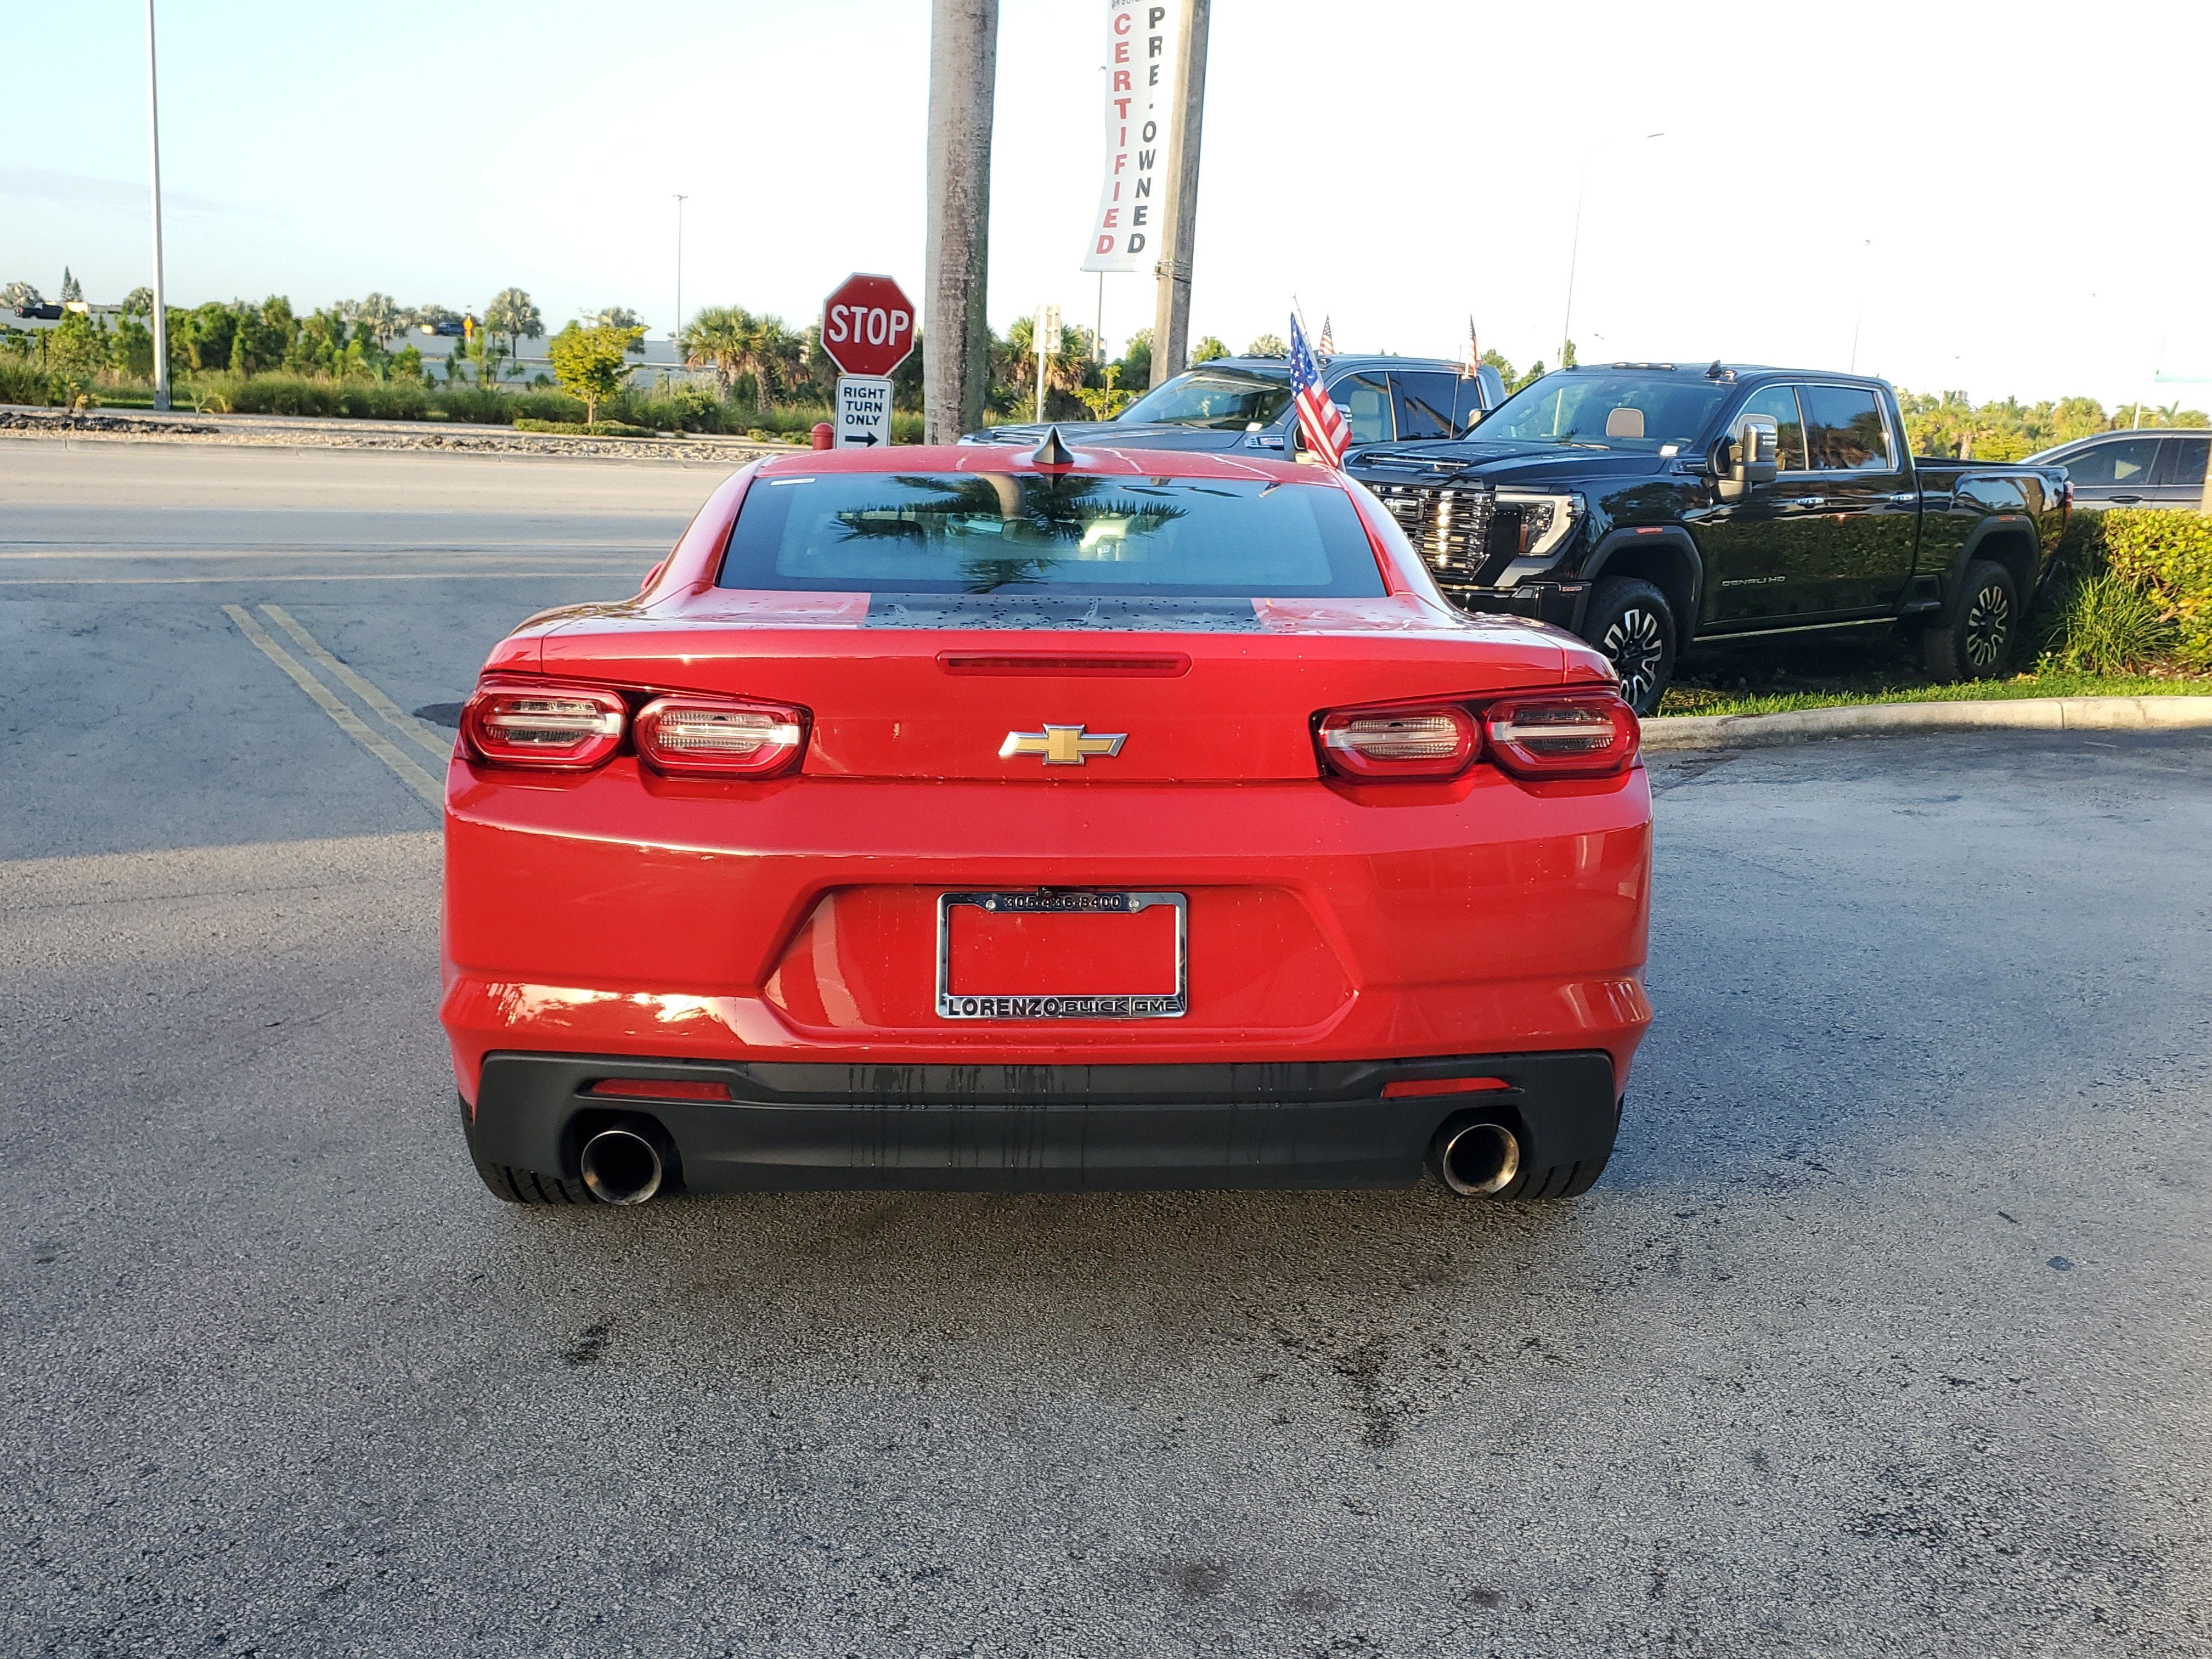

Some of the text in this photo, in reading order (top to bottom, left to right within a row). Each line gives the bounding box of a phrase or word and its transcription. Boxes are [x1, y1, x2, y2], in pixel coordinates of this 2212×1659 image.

[1096, 13, 1131, 254] CERTIFIED
[828, 304, 909, 346] STOP
[844, 387, 886, 399] RIGHT
[845, 400, 883, 413] TURN
[845, 414, 881, 426] ONLY
[1722, 578, 1767, 586] DENALI
[1005, 895, 1121, 909] 305-436-8400
[948, 997, 1179, 1015] LORENZO BUICK GMC
